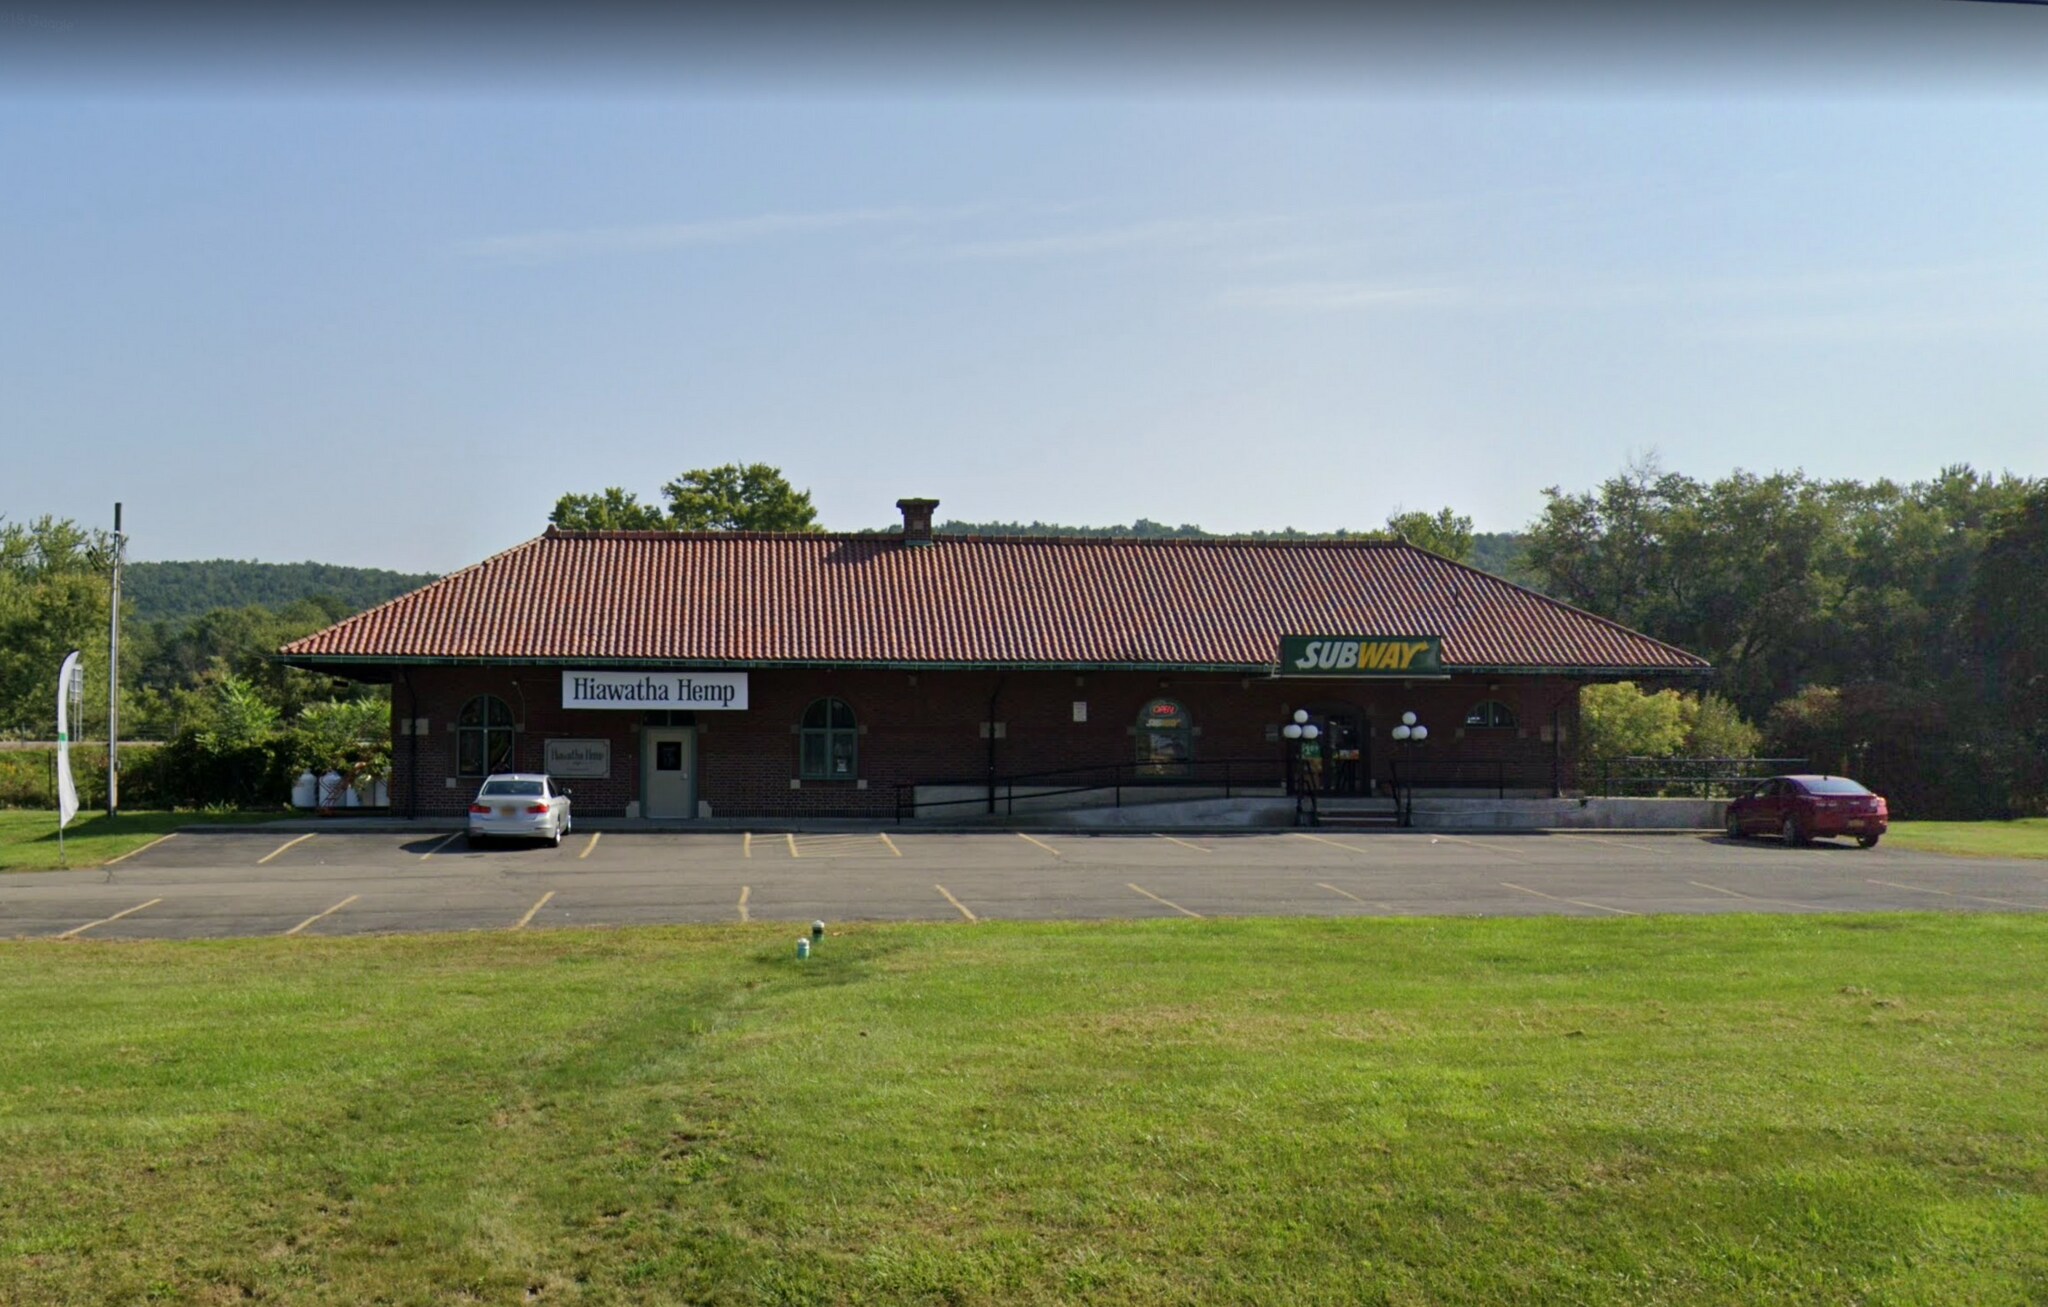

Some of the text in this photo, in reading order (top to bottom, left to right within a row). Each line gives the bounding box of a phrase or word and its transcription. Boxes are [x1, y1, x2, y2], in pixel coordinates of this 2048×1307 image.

[1295, 640, 1429, 671] SUBWAY
[573, 676, 735, 707] Hiawatha Hemp
[1152, 704, 1176, 714] OPEN
